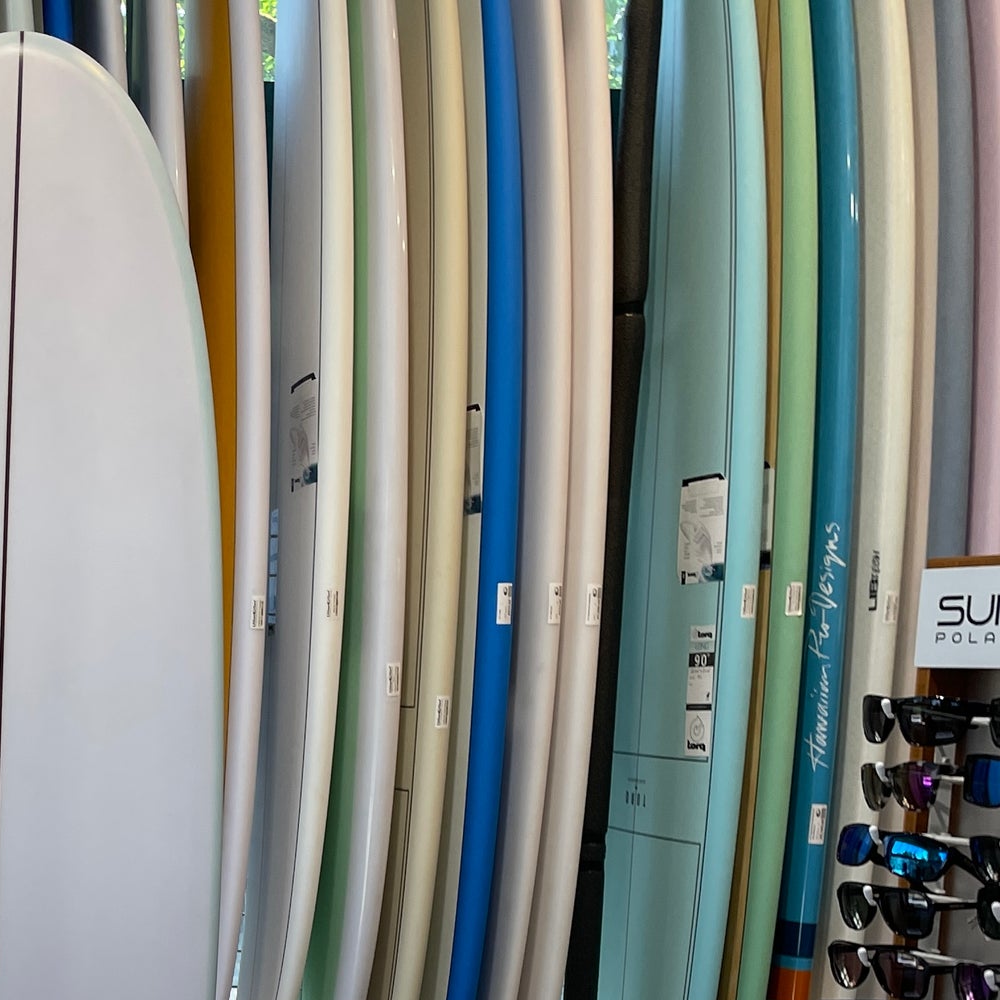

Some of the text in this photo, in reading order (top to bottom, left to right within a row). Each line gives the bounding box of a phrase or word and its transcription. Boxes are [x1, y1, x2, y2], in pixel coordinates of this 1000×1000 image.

[697, 630, 713, 639] torq
[936, 631, 996, 644] POLA
[687, 740, 706, 752] torq
